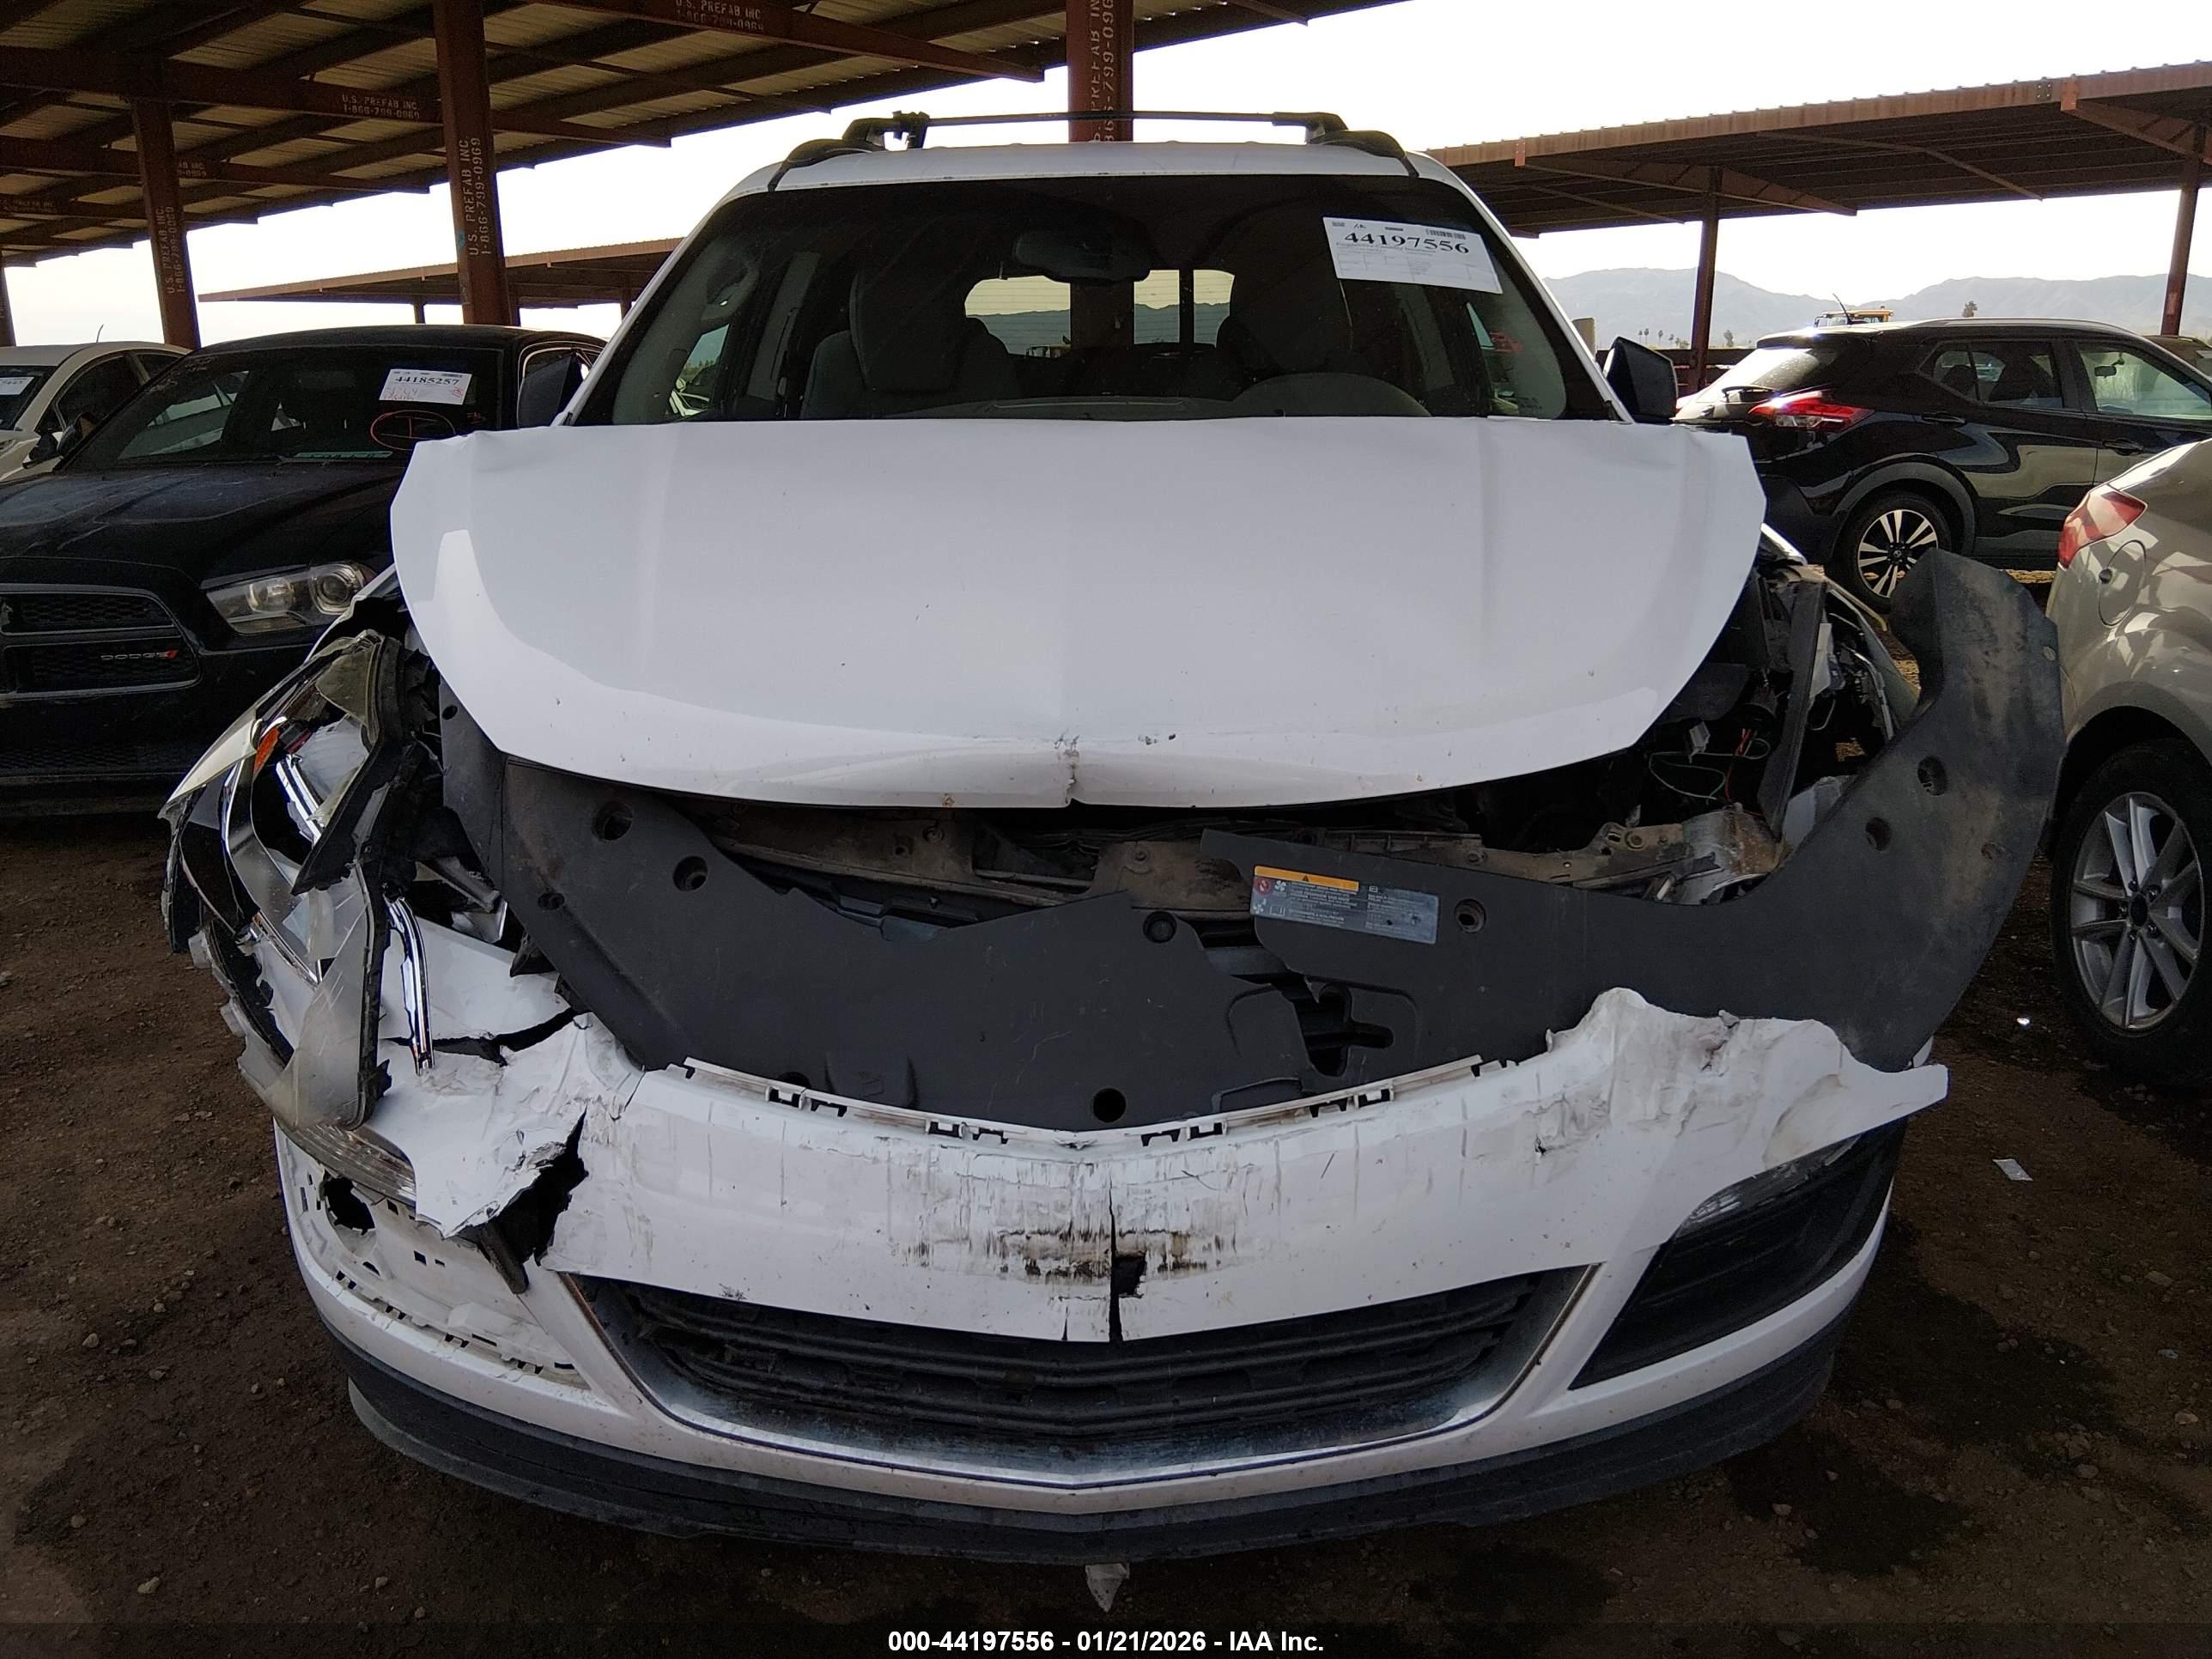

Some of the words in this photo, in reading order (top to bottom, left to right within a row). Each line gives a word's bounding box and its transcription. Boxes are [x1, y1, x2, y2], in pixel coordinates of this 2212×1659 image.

[701, 0, 741, 16] PREFAB
[1091, 31, 1100, 111] PREFAB
[364, 96, 399, 109] PREFAB
[460, 169, 476, 222] PREFAB
[471, 137, 491, 255] 1-866-799-0969
[158, 229, 172, 269] PREFAB
[467, 229, 479, 256] U.S.
[1345, 231, 1470, 255] 44197556
[395, 376, 460, 386] 44185257
